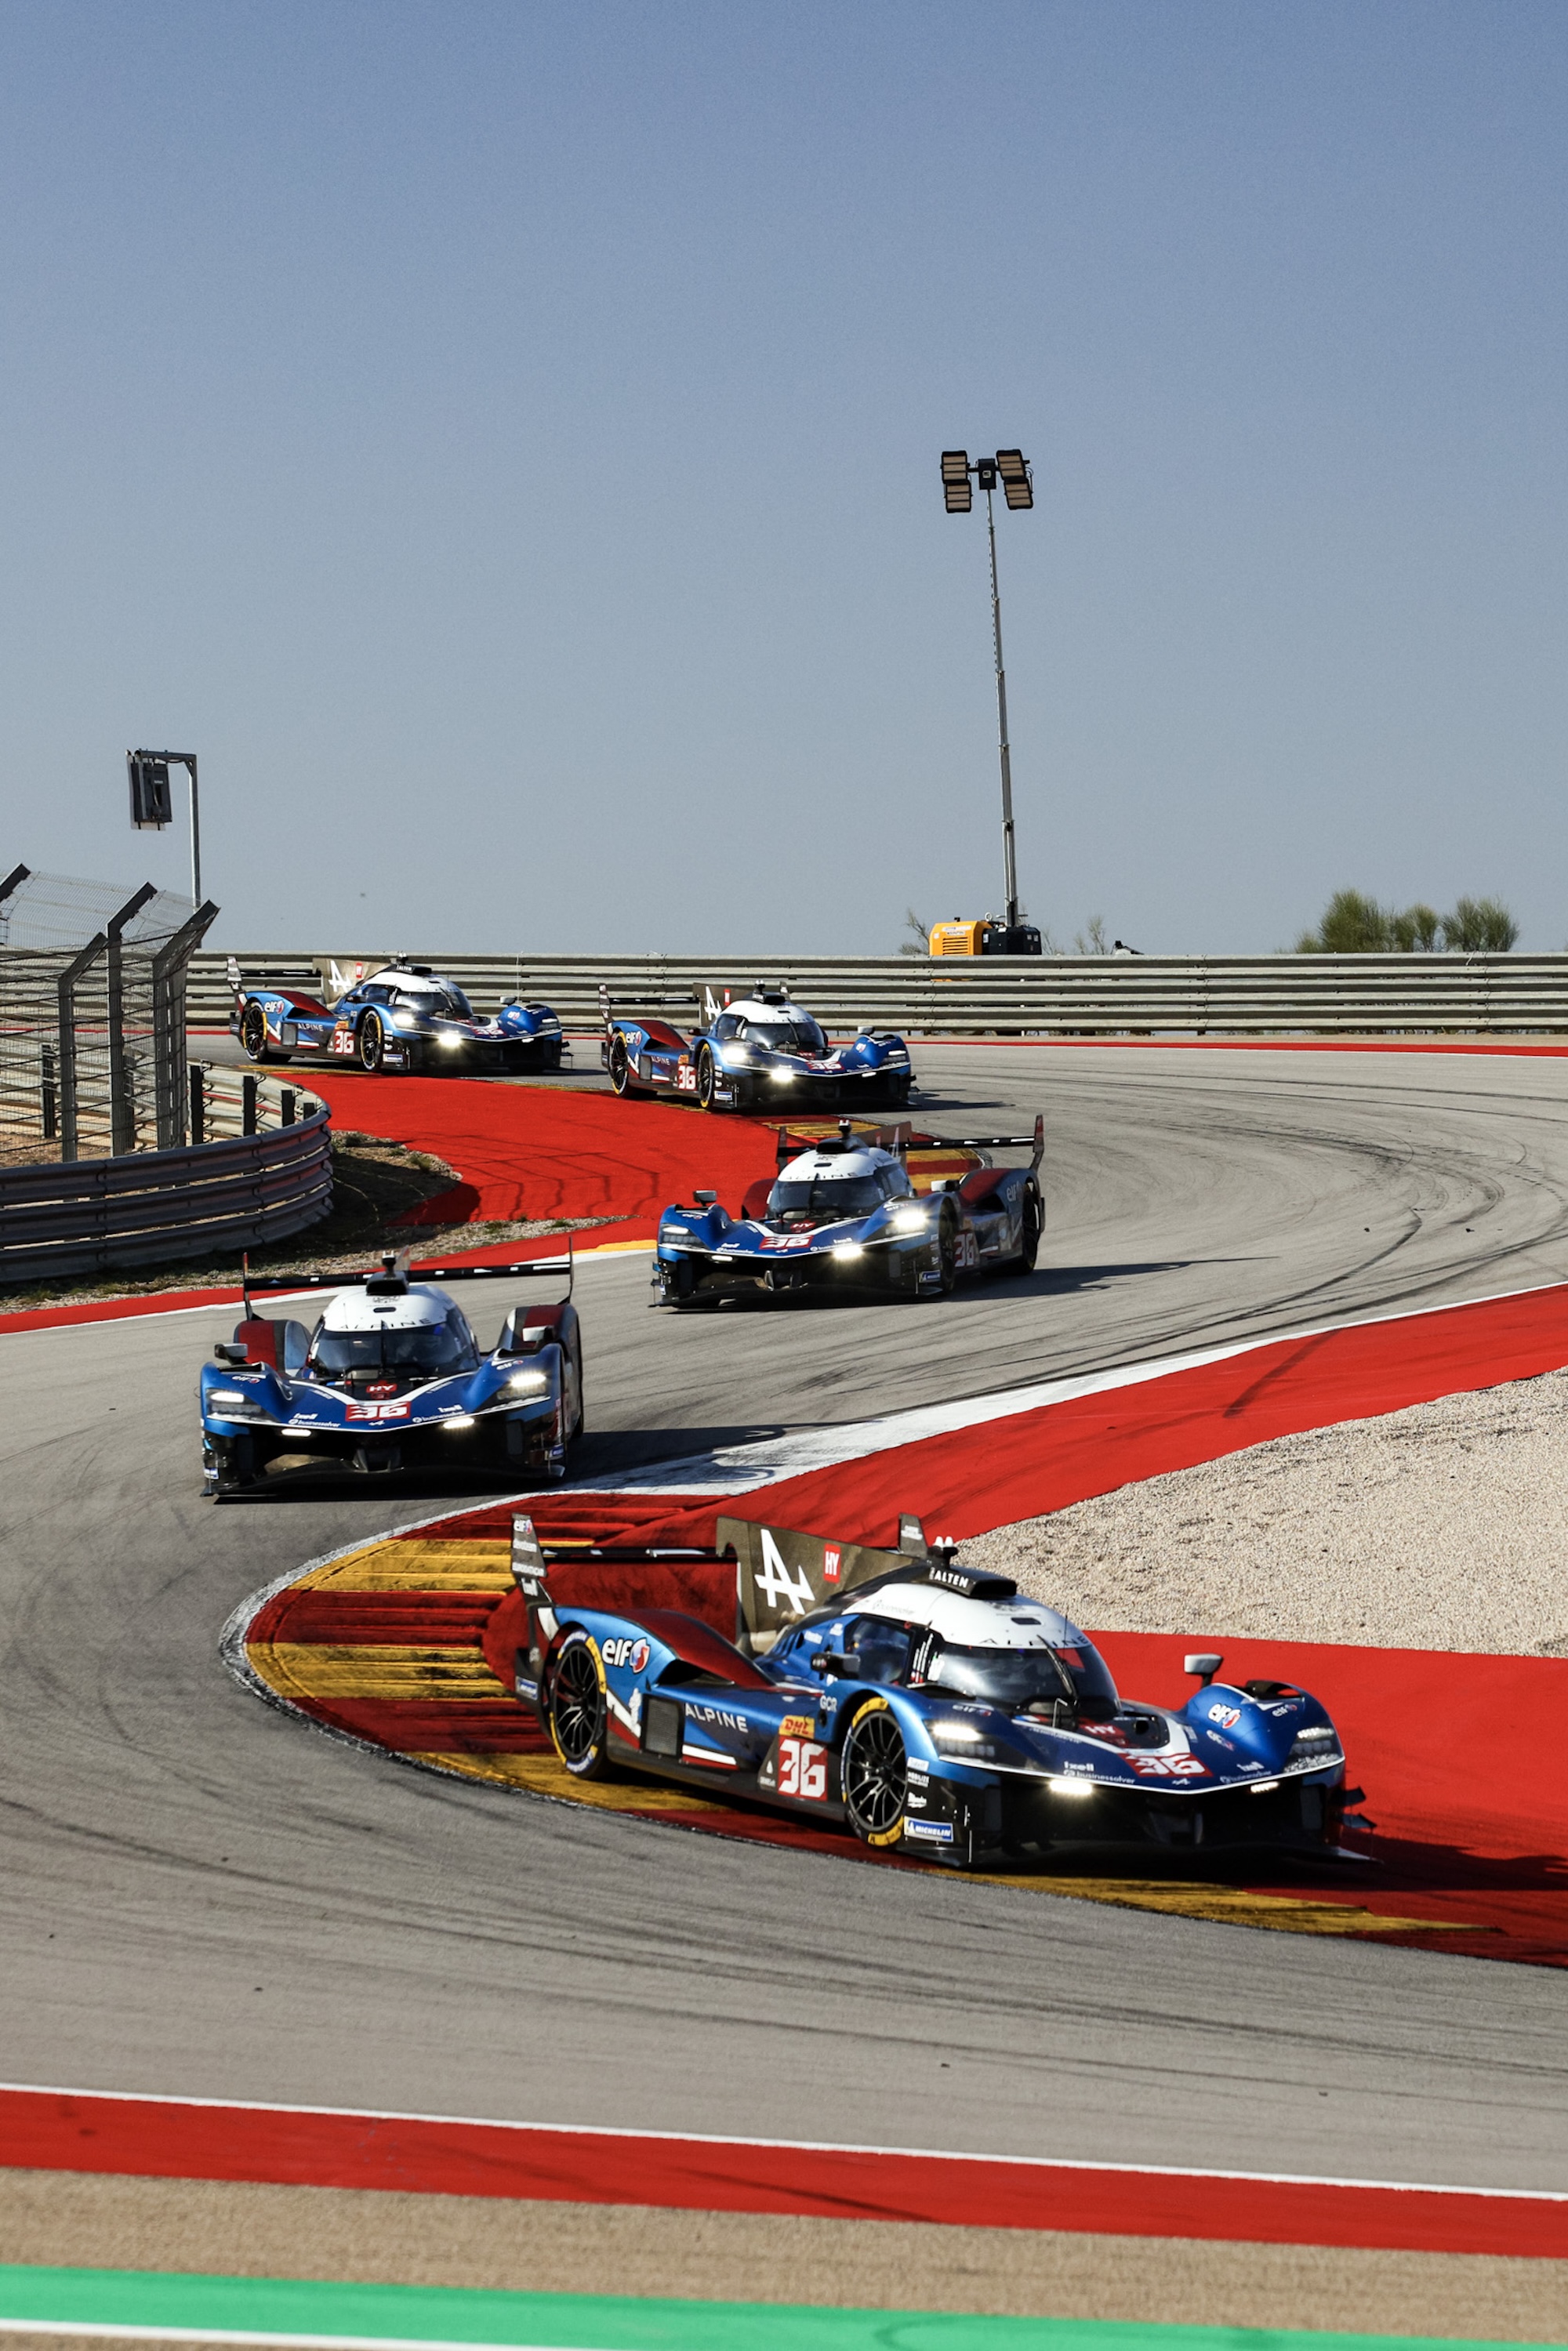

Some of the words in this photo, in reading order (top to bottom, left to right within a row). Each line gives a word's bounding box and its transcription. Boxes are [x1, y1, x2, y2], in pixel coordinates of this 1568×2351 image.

[298, 1023, 324, 1032] ALPINE
[335, 1031, 354, 1054] 36
[679, 1065, 696, 1090] 36
[761, 1235, 811, 1248] 36
[954, 1232, 975, 1267] 36
[348, 1401, 408, 1419] 36
[825, 1551, 840, 1576] HY
[934, 1569, 969, 1588] ALTEN
[601, 1638, 633, 1667] elf
[684, 1702, 749, 1733] ALPINE
[784, 1718, 809, 1736] DHL
[1084, 1725, 1116, 1735] HY
[779, 1738, 826, 1798] 36
[1126, 1754, 1206, 1776] 36
[1076, 1770, 1135, 1784] businessolver
[915, 1824, 951, 1837] MICHELIN
